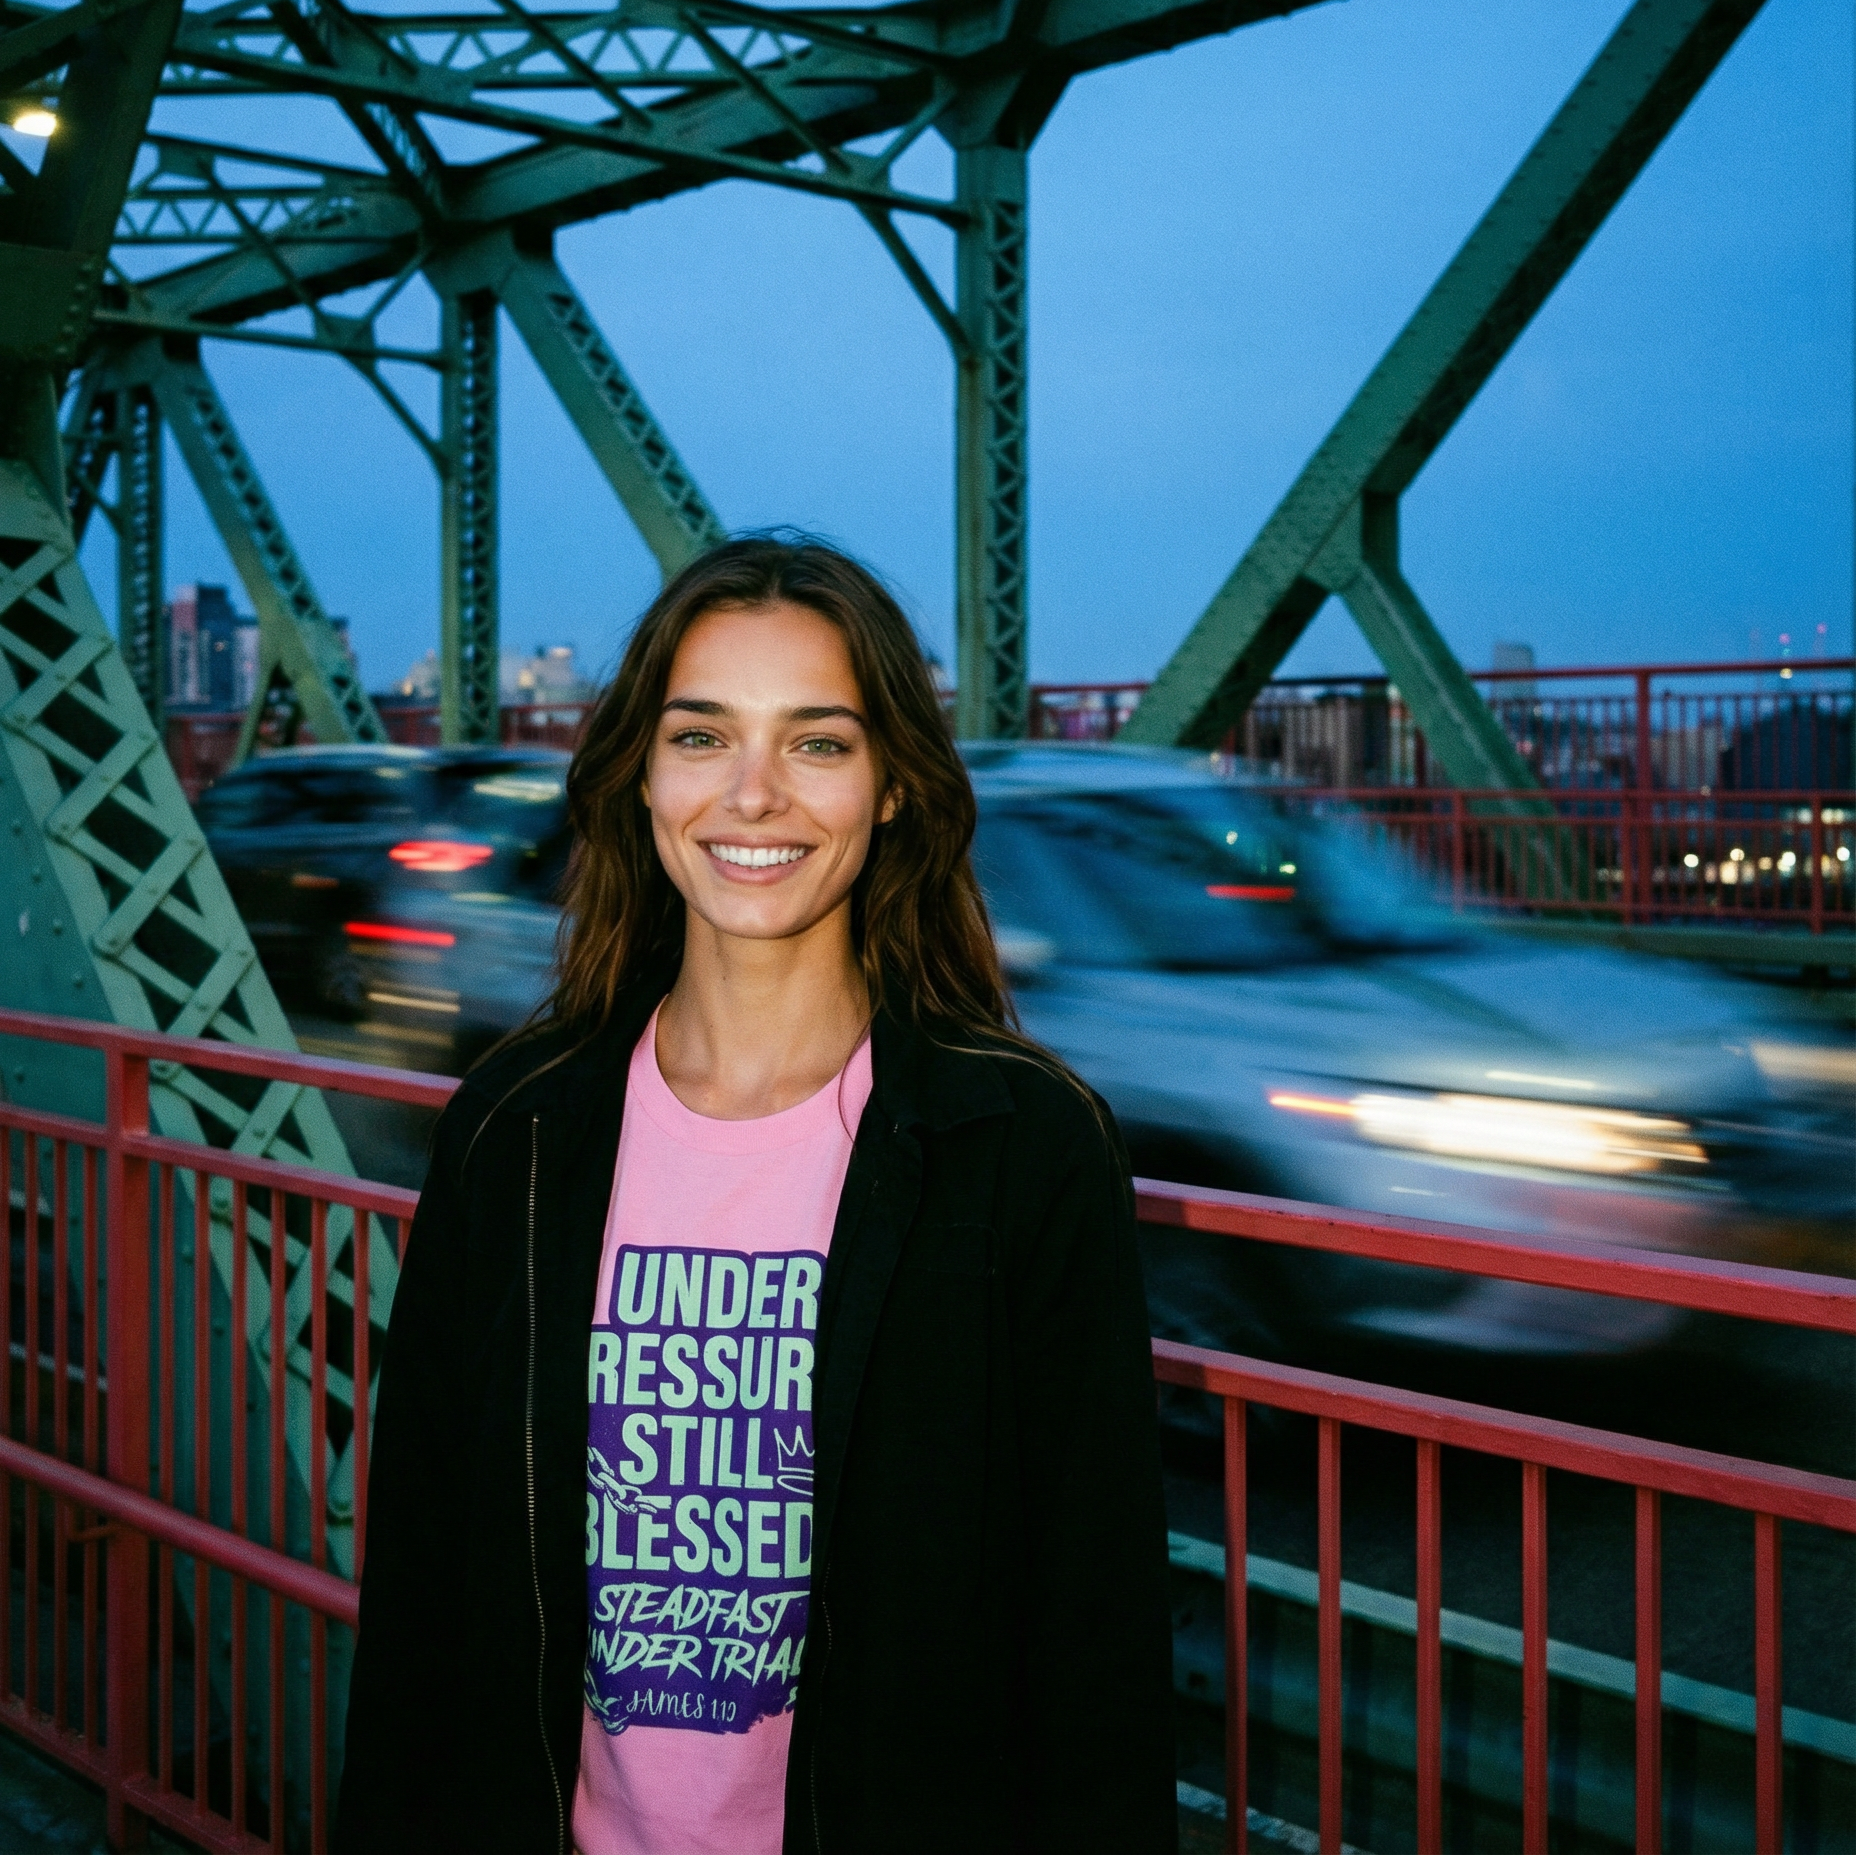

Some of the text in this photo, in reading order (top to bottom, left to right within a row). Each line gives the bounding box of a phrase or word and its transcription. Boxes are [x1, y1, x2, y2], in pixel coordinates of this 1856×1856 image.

[617, 1251, 822, 1330] UNDER
[588, 1331, 815, 1412] RESSUR
[619, 1412, 774, 1490] STILL
[594, 1582, 811, 1638] STEADFAST
[626, 1688, 705, 1720] JAMES
